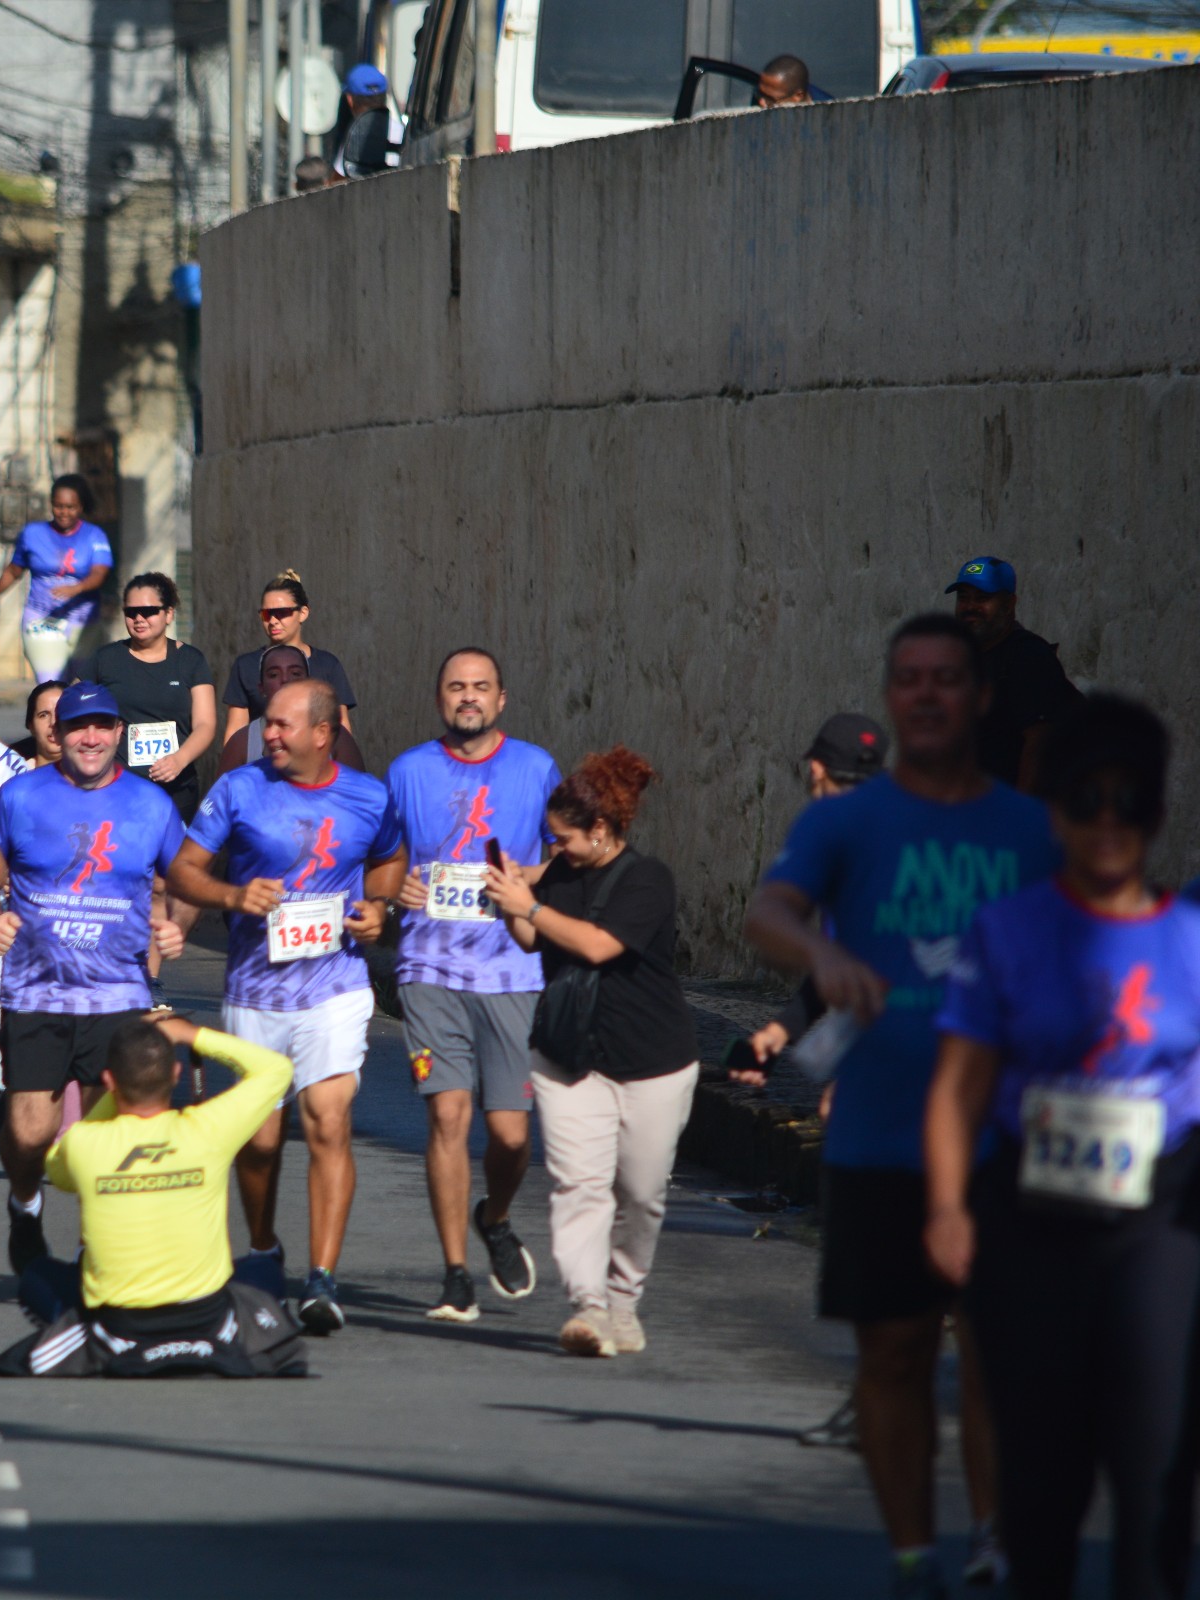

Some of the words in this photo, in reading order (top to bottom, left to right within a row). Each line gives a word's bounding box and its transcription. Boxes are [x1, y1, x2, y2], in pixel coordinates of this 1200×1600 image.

[134, 739, 171, 755] 5179
[890, 839, 1017, 900] MOVI
[33, 893, 68, 905] CORRIDA
[69, 895, 81, 905] DE
[82, 896, 132, 910] ANIVERSÁRIO
[434, 885, 490, 908] 5268
[69, 909, 84, 919] DOS
[52, 920, 104, 940] 432
[278, 922, 333, 948] 1342
[97, 1171, 203, 1192] FOTÓGRAFO
